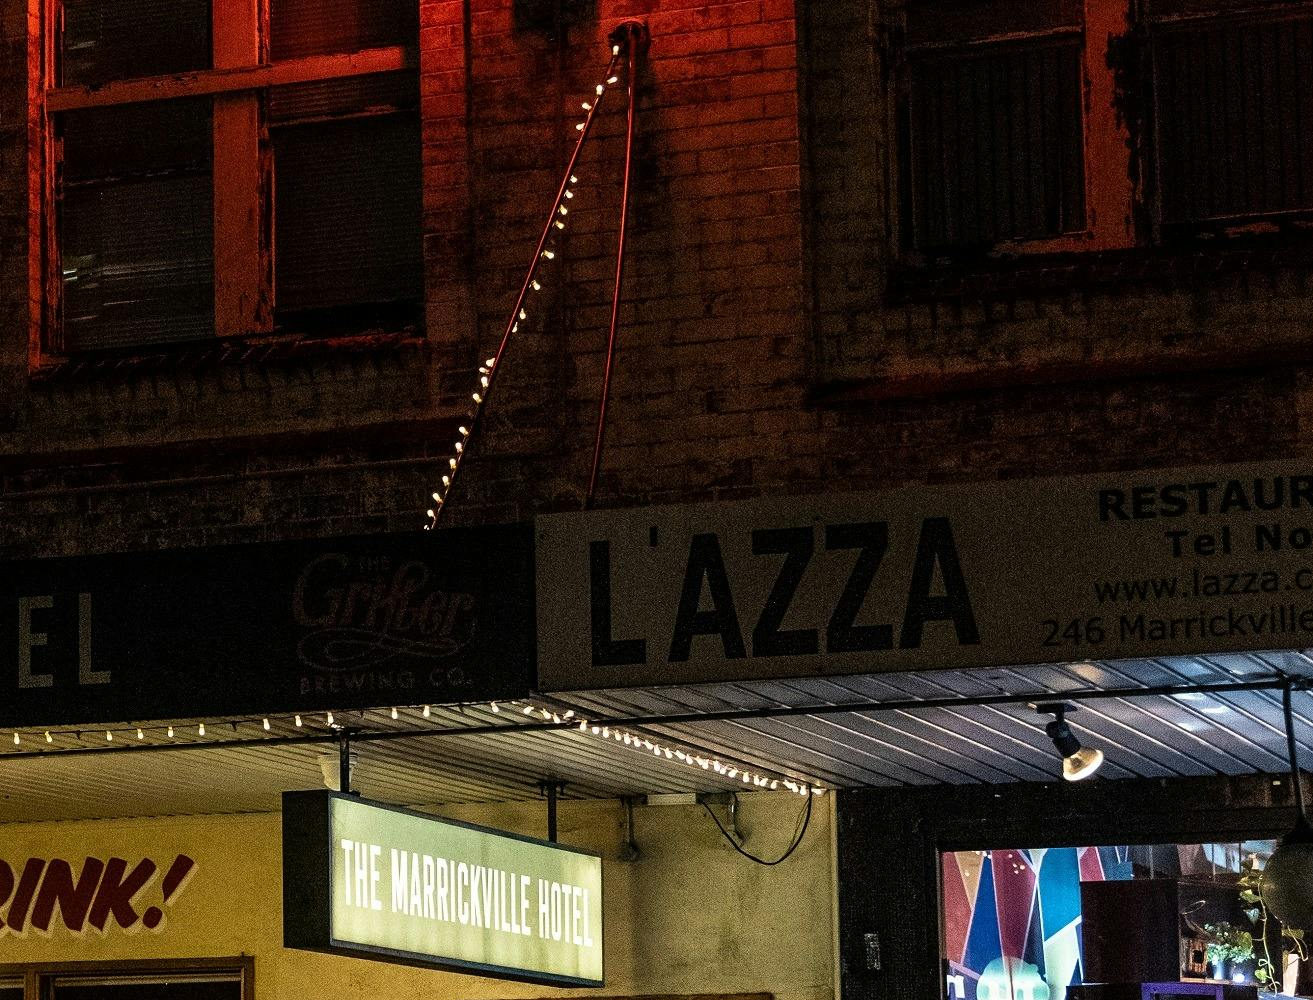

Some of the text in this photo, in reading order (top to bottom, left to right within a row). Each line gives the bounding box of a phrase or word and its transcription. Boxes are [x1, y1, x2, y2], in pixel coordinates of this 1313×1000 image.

[1098, 474, 1313, 521] RESTAUR
[1165, 523, 1313, 557] Tel No
[589, 516, 980, 686] L'AZZA
[1095, 567, 1313, 603] www.lazza.c
[1042, 604, 1313, 646] 246 Marrickville
[341, 839, 593, 947] THE MARRICKVILLE HOTEL
